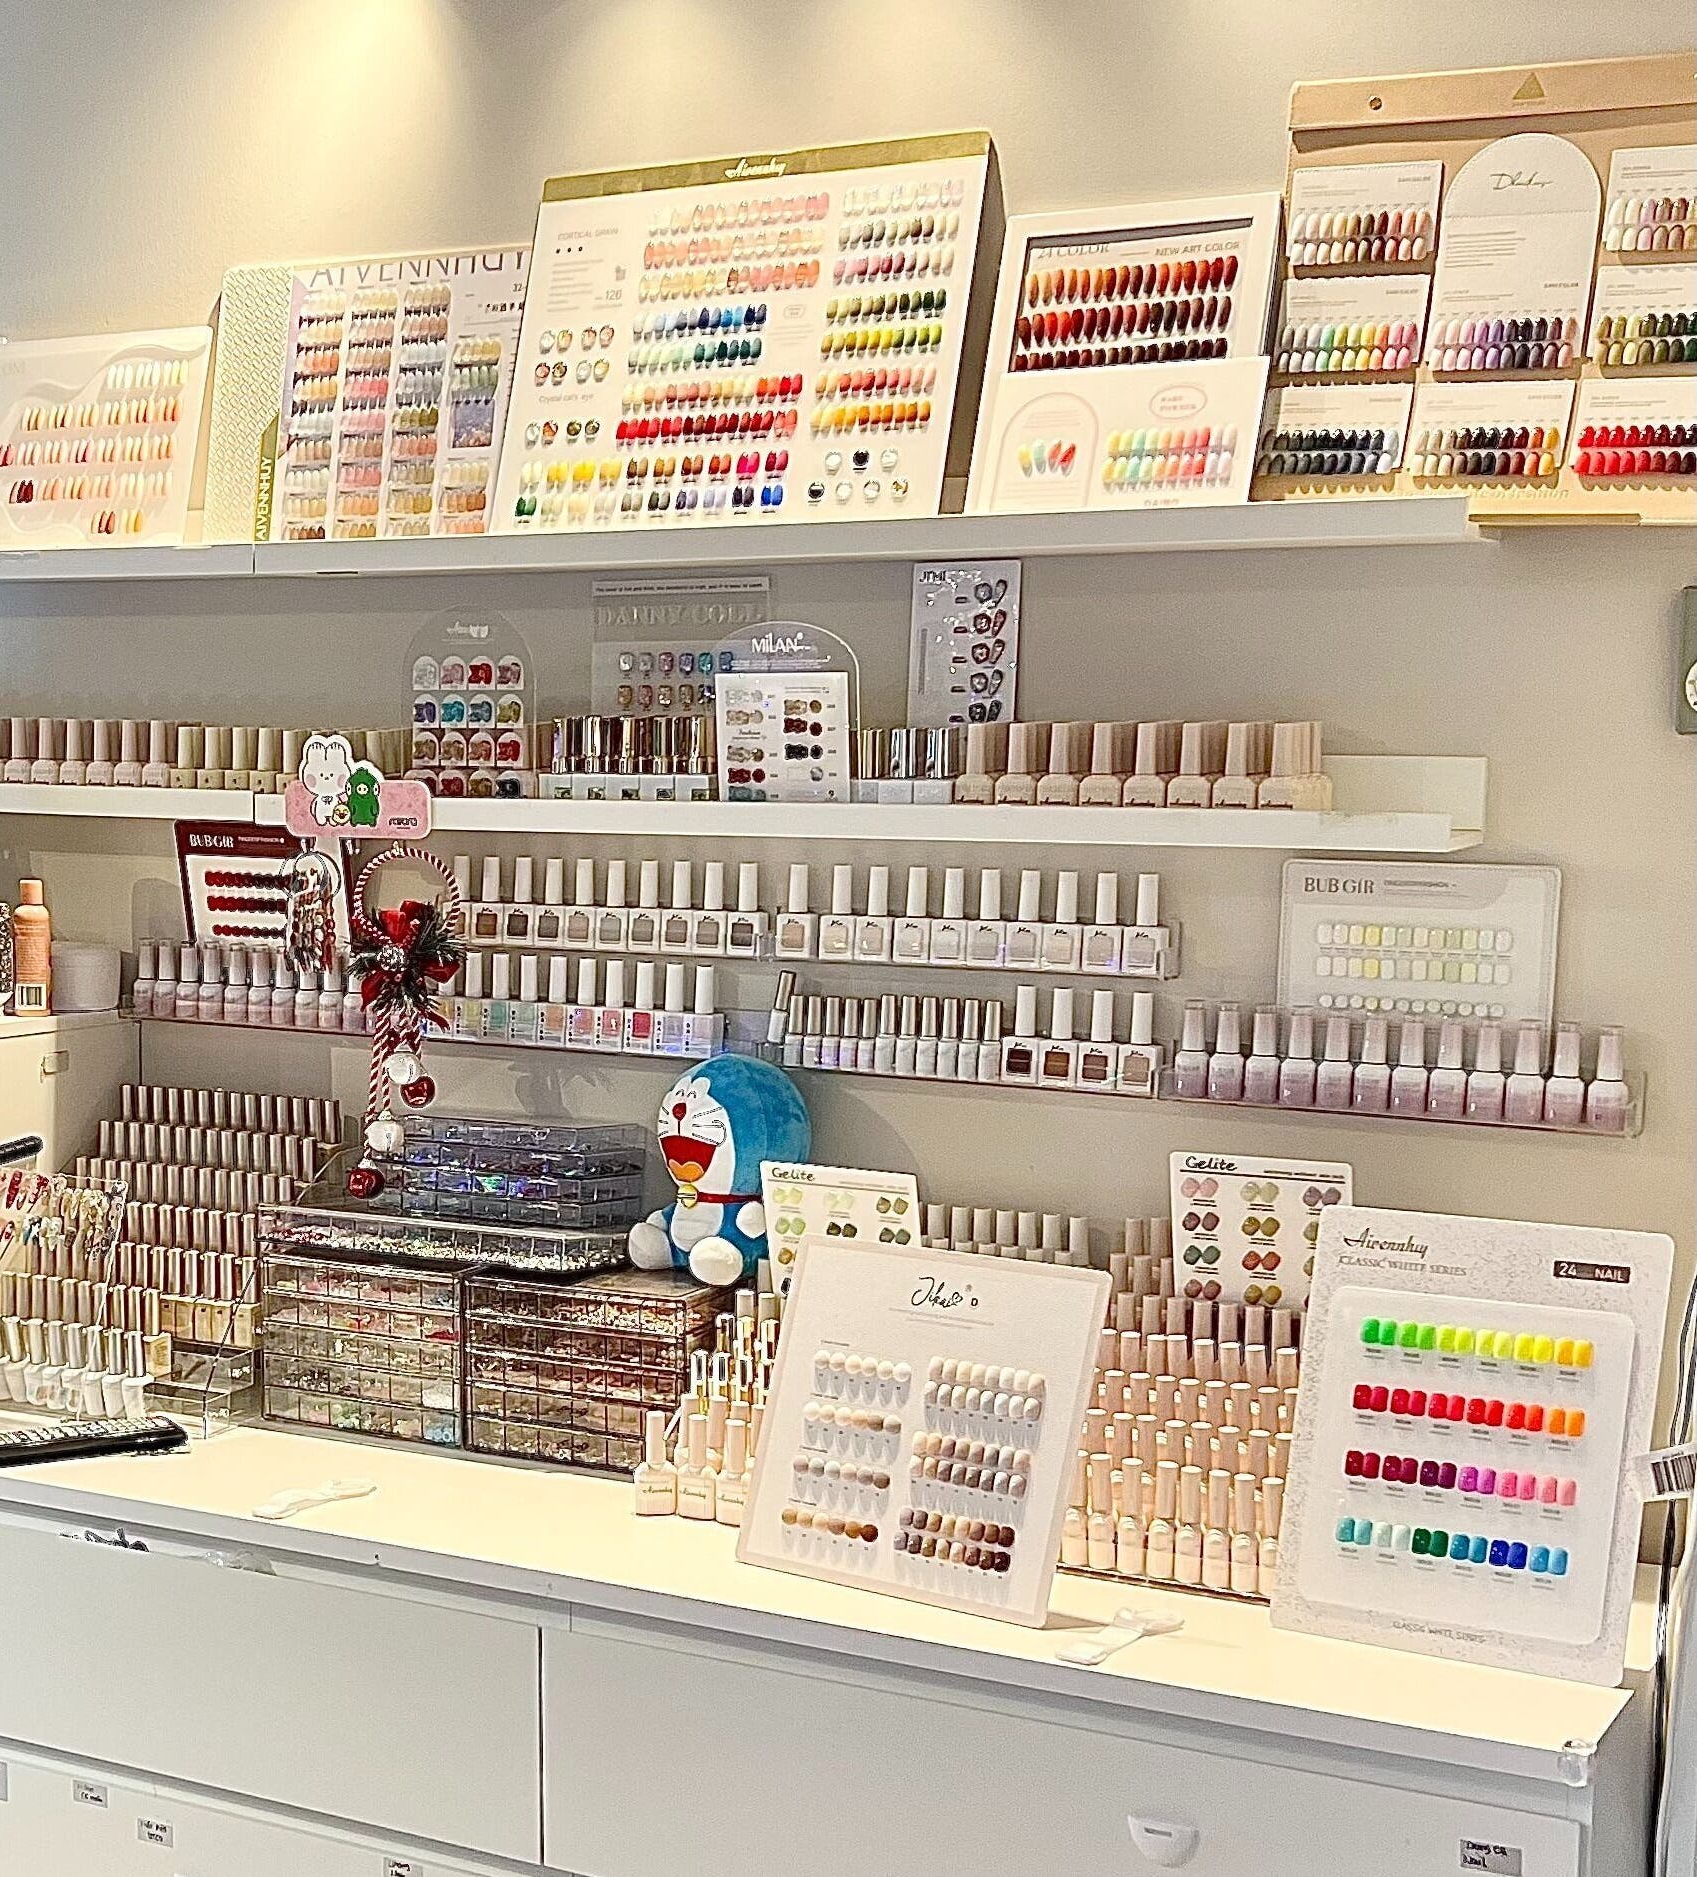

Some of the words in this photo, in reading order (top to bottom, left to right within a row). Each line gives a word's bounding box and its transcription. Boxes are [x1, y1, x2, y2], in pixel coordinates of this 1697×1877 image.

[1182, 245, 1202, 255] ART
[1304, 877, 1339, 893] BUB
[1185, 1155, 1238, 1171] Gelite
[771, 1166, 815, 1182] Gelite
[1338, 1255, 1386, 1269] CLASSIC
[1388, 1260, 1427, 1272] WHITE
[1430, 1264, 1468, 1277] SERIES
[1558, 1262, 1578, 1277] 24
[1594, 1267, 1625, 1283] NAIL
